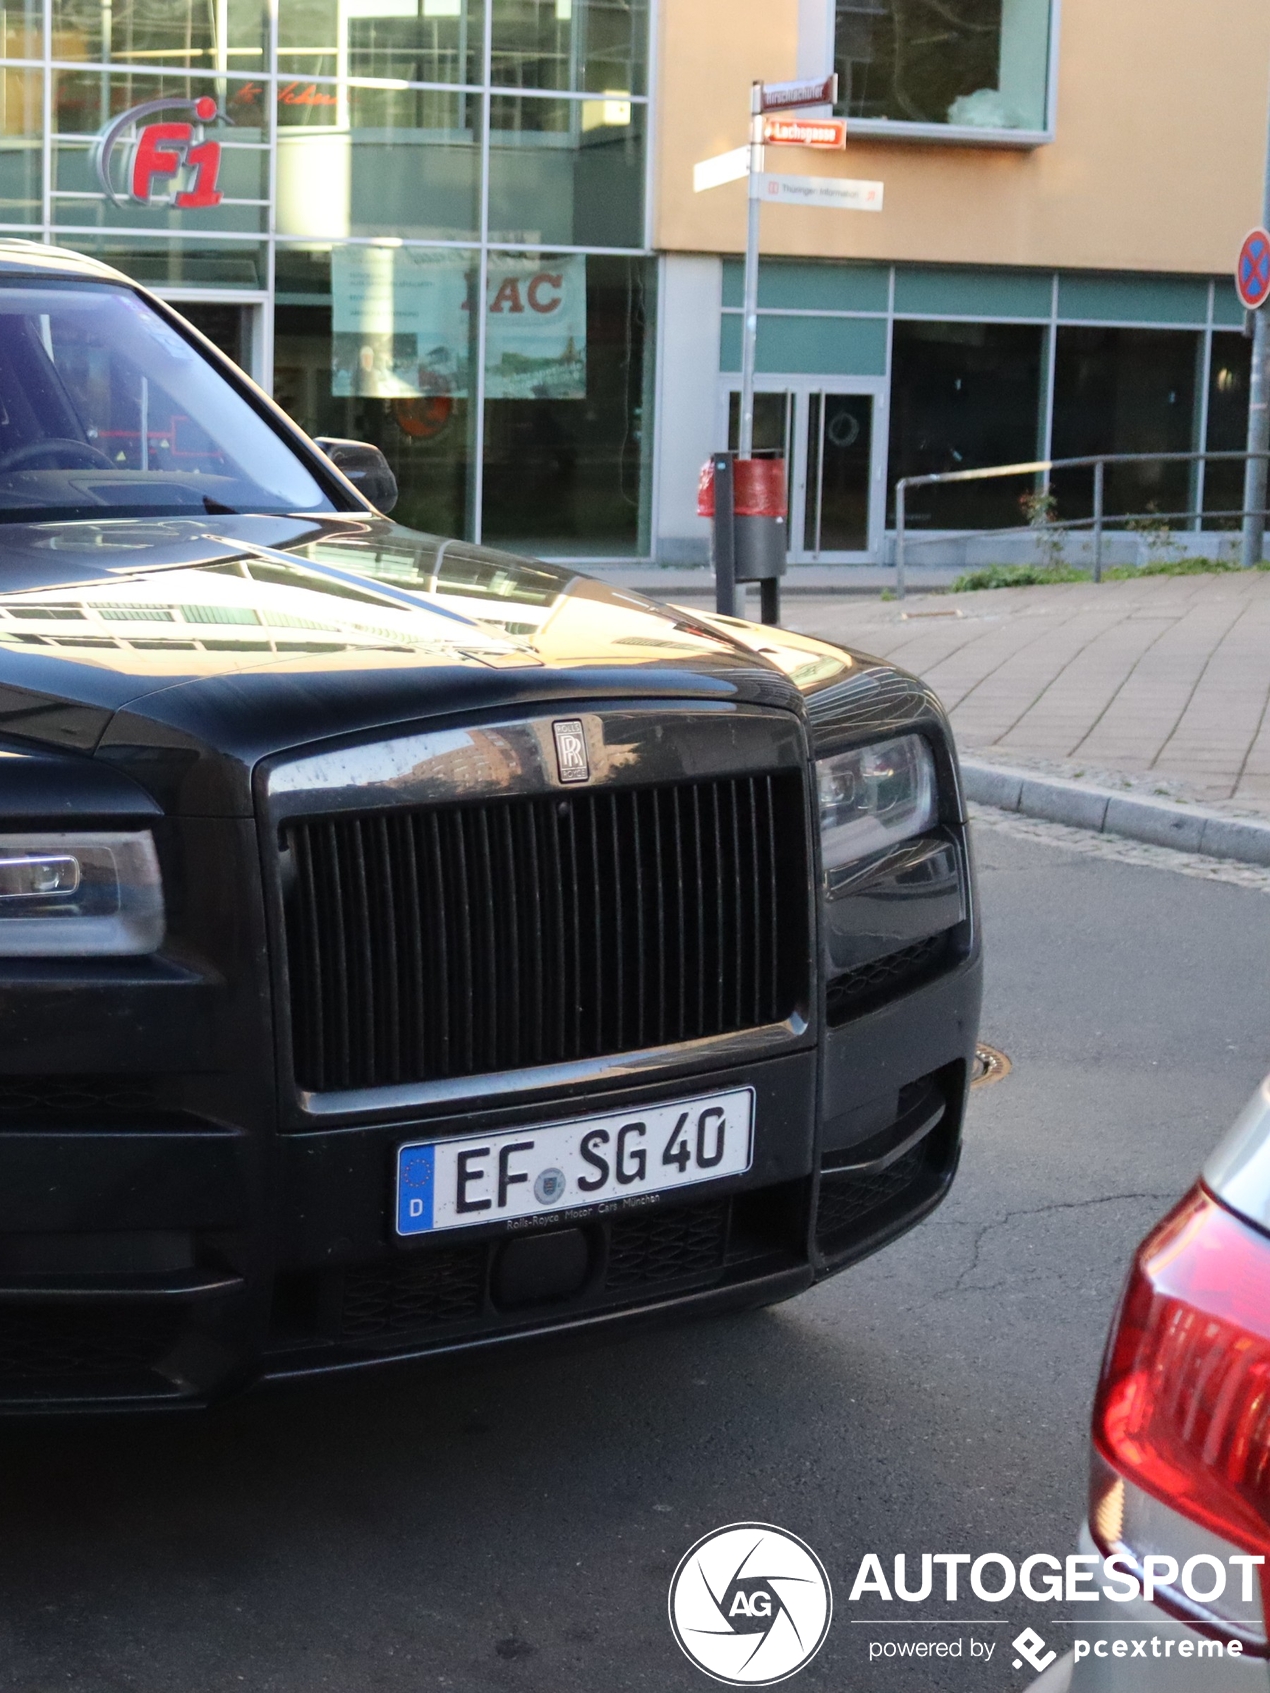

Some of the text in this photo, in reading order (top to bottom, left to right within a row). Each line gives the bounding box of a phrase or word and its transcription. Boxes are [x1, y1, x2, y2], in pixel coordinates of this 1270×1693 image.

[775, 123, 835, 144] Lachsgasse
[132, 121, 224, 209] F1
[557, 723, 580, 732] ROLLS
[563, 769, 586, 778] ROYCE
[456, 1106, 726, 1214] EF SG 40
[409, 1198, 423, 1217] D
[506, 1193, 661, 1230] Rolls-Royce Motor Cars München
